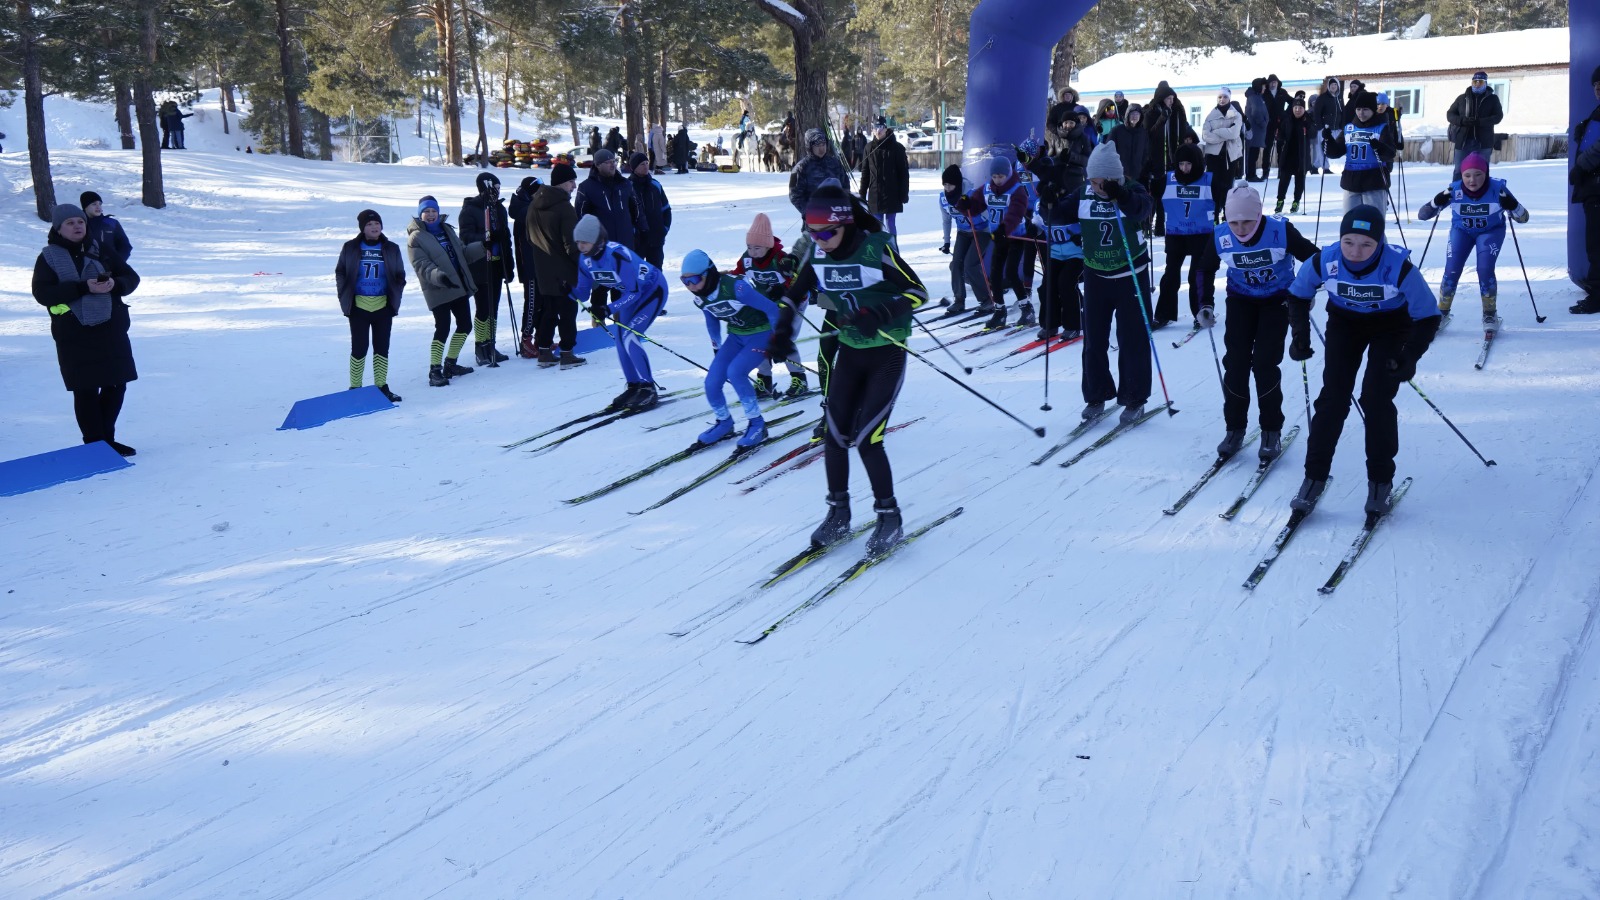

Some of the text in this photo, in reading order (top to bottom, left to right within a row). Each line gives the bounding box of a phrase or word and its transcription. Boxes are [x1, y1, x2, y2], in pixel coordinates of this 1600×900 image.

[1351, 144, 1367, 160] 91
[990, 208, 1004, 224] 27
[1183, 201, 1191, 219] 7
[1461, 217, 1488, 229] 95
[1099, 221, 1114, 246] 2
[1094, 249, 1121, 259] SEMEY
[362, 262, 379, 279] 71
[1243, 268, 1278, 284] 62
